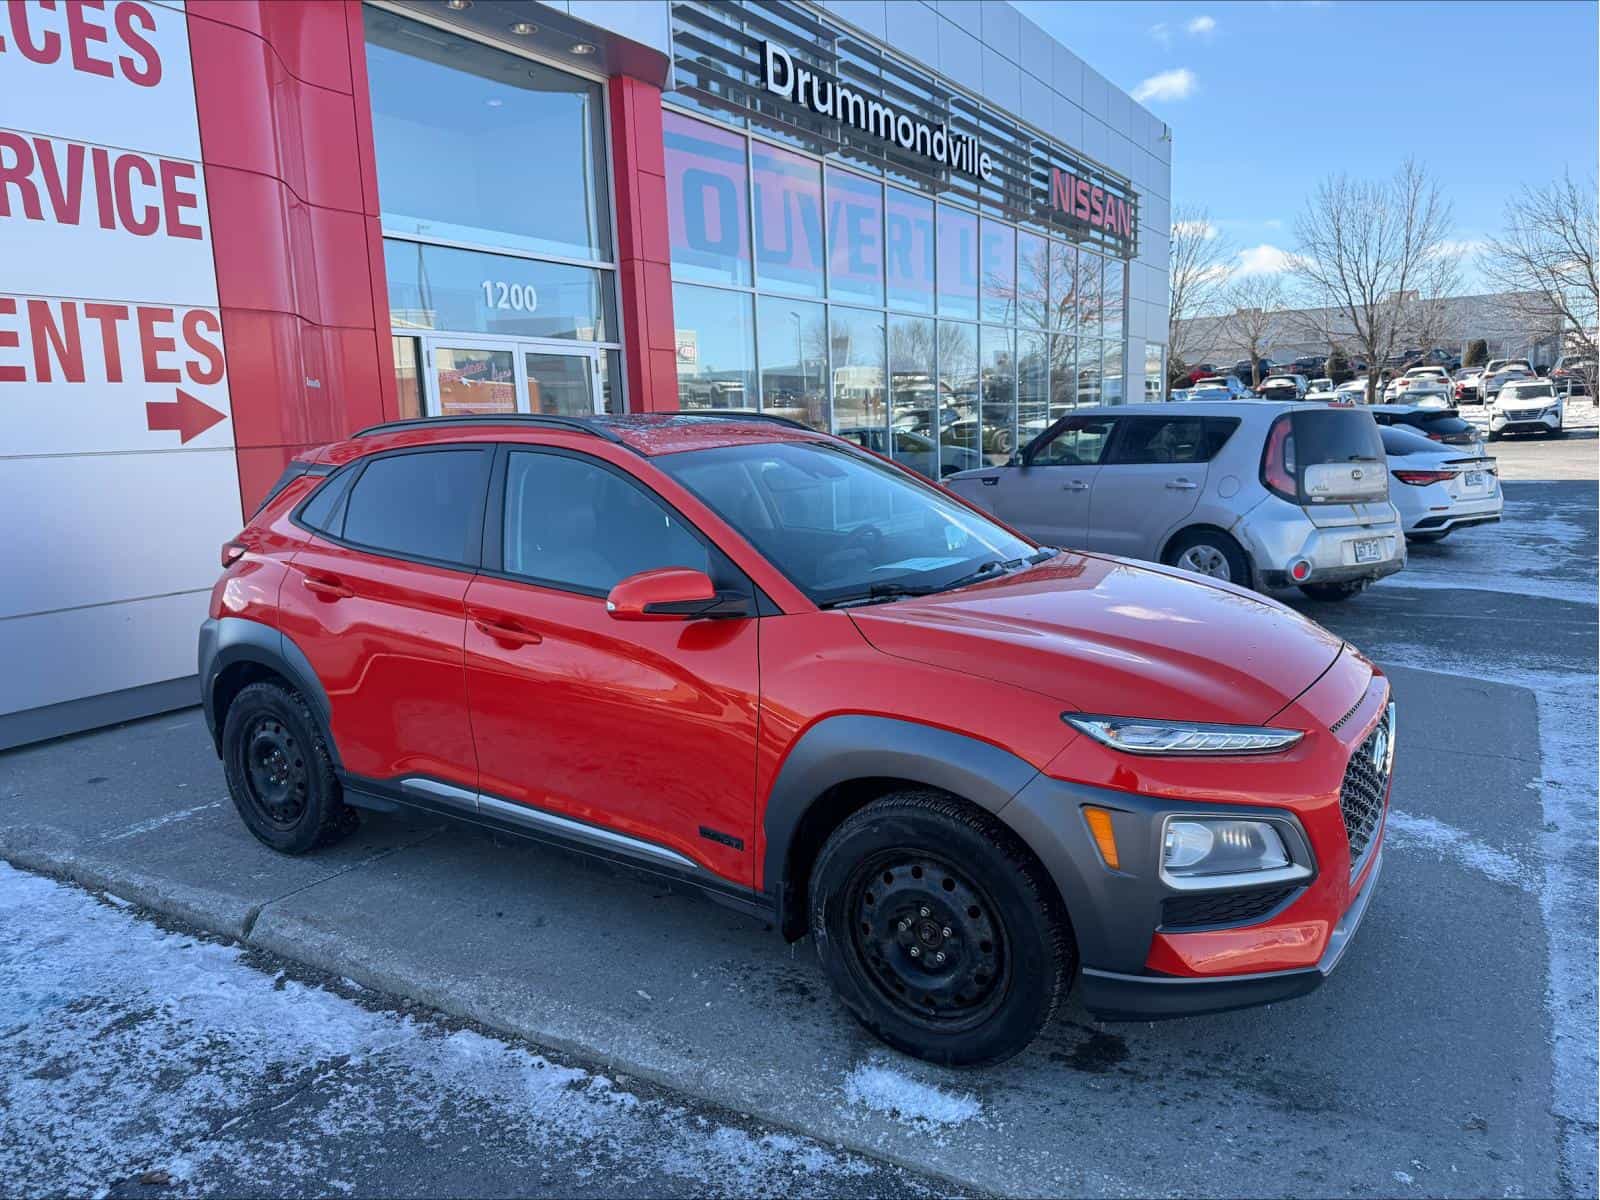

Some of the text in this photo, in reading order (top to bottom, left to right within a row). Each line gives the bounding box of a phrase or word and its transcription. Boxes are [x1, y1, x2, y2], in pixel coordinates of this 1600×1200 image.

[0, 0, 162, 87] CES
[763, 40, 993, 181] Drummondville
[0, 132, 203, 240] RVICE
[682, 167, 943, 283] OUVERT
[1051, 167, 1132, 238] NISSAN
[482, 280, 537, 312] 1200
